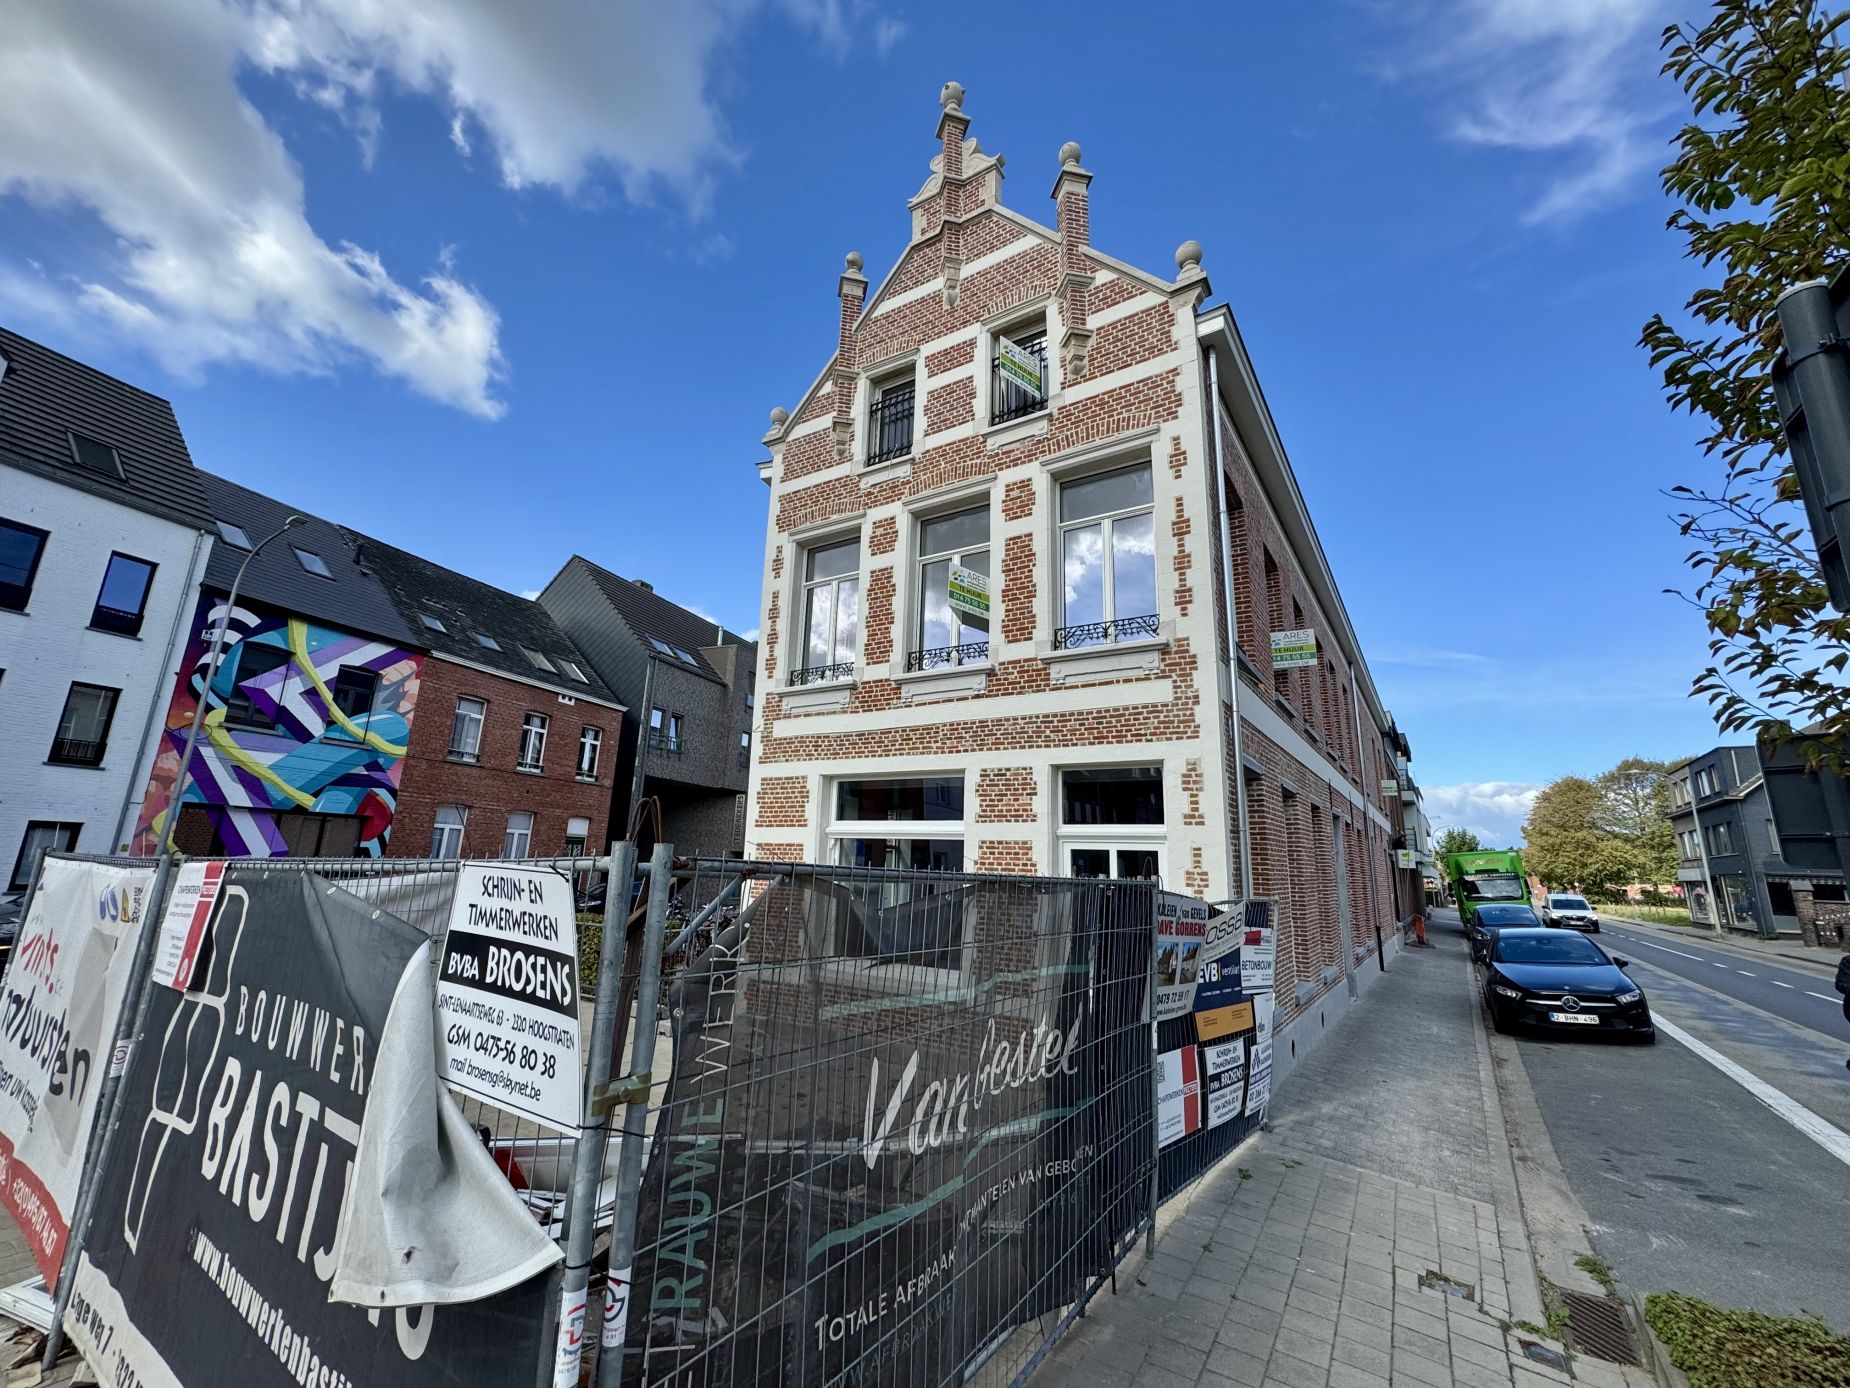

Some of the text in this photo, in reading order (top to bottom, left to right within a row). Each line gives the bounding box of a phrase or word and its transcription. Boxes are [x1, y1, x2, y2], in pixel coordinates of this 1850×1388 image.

[1017, 350, 1037, 368] ARES
[967, 572, 986, 586] ARES
[967, 588, 982, 599] HUUR
[1283, 631, 1309, 640] ARES
[482, 874, 544, 905] SCHRIJN- EN
[468, 903, 559, 942] TIMMERWERKEN
[1176, 921, 1206, 937] GORRENS
[1191, 907, 1206, 920] GEVELS
[448, 945, 572, 1007] BVBA BROSENS
[1221, 965, 1240, 977] ventilat
[1242, 960, 1272, 971] BETONBOUW
[438, 994, 496, 1026] SINT-LENAARTSEWEG
[496, 1010, 505, 1027] 63
[511, 1013, 527, 1033] 2320
[528, 1018, 575, 1051] HOOGSTRATEN
[235, 985, 365, 1095] BOUWWER
[447, 1023, 556, 1079] GSM 0475-56 80 38
[450, 1057, 541, 1102] mail brosensg@skynet.be
[815, 1292, 887, 1351] TOTALE
[894, 1246, 957, 1308] AFBRAAK
[1018, 1165, 1042, 1186] VAN
[101, 1325, 114, 1356] 7
